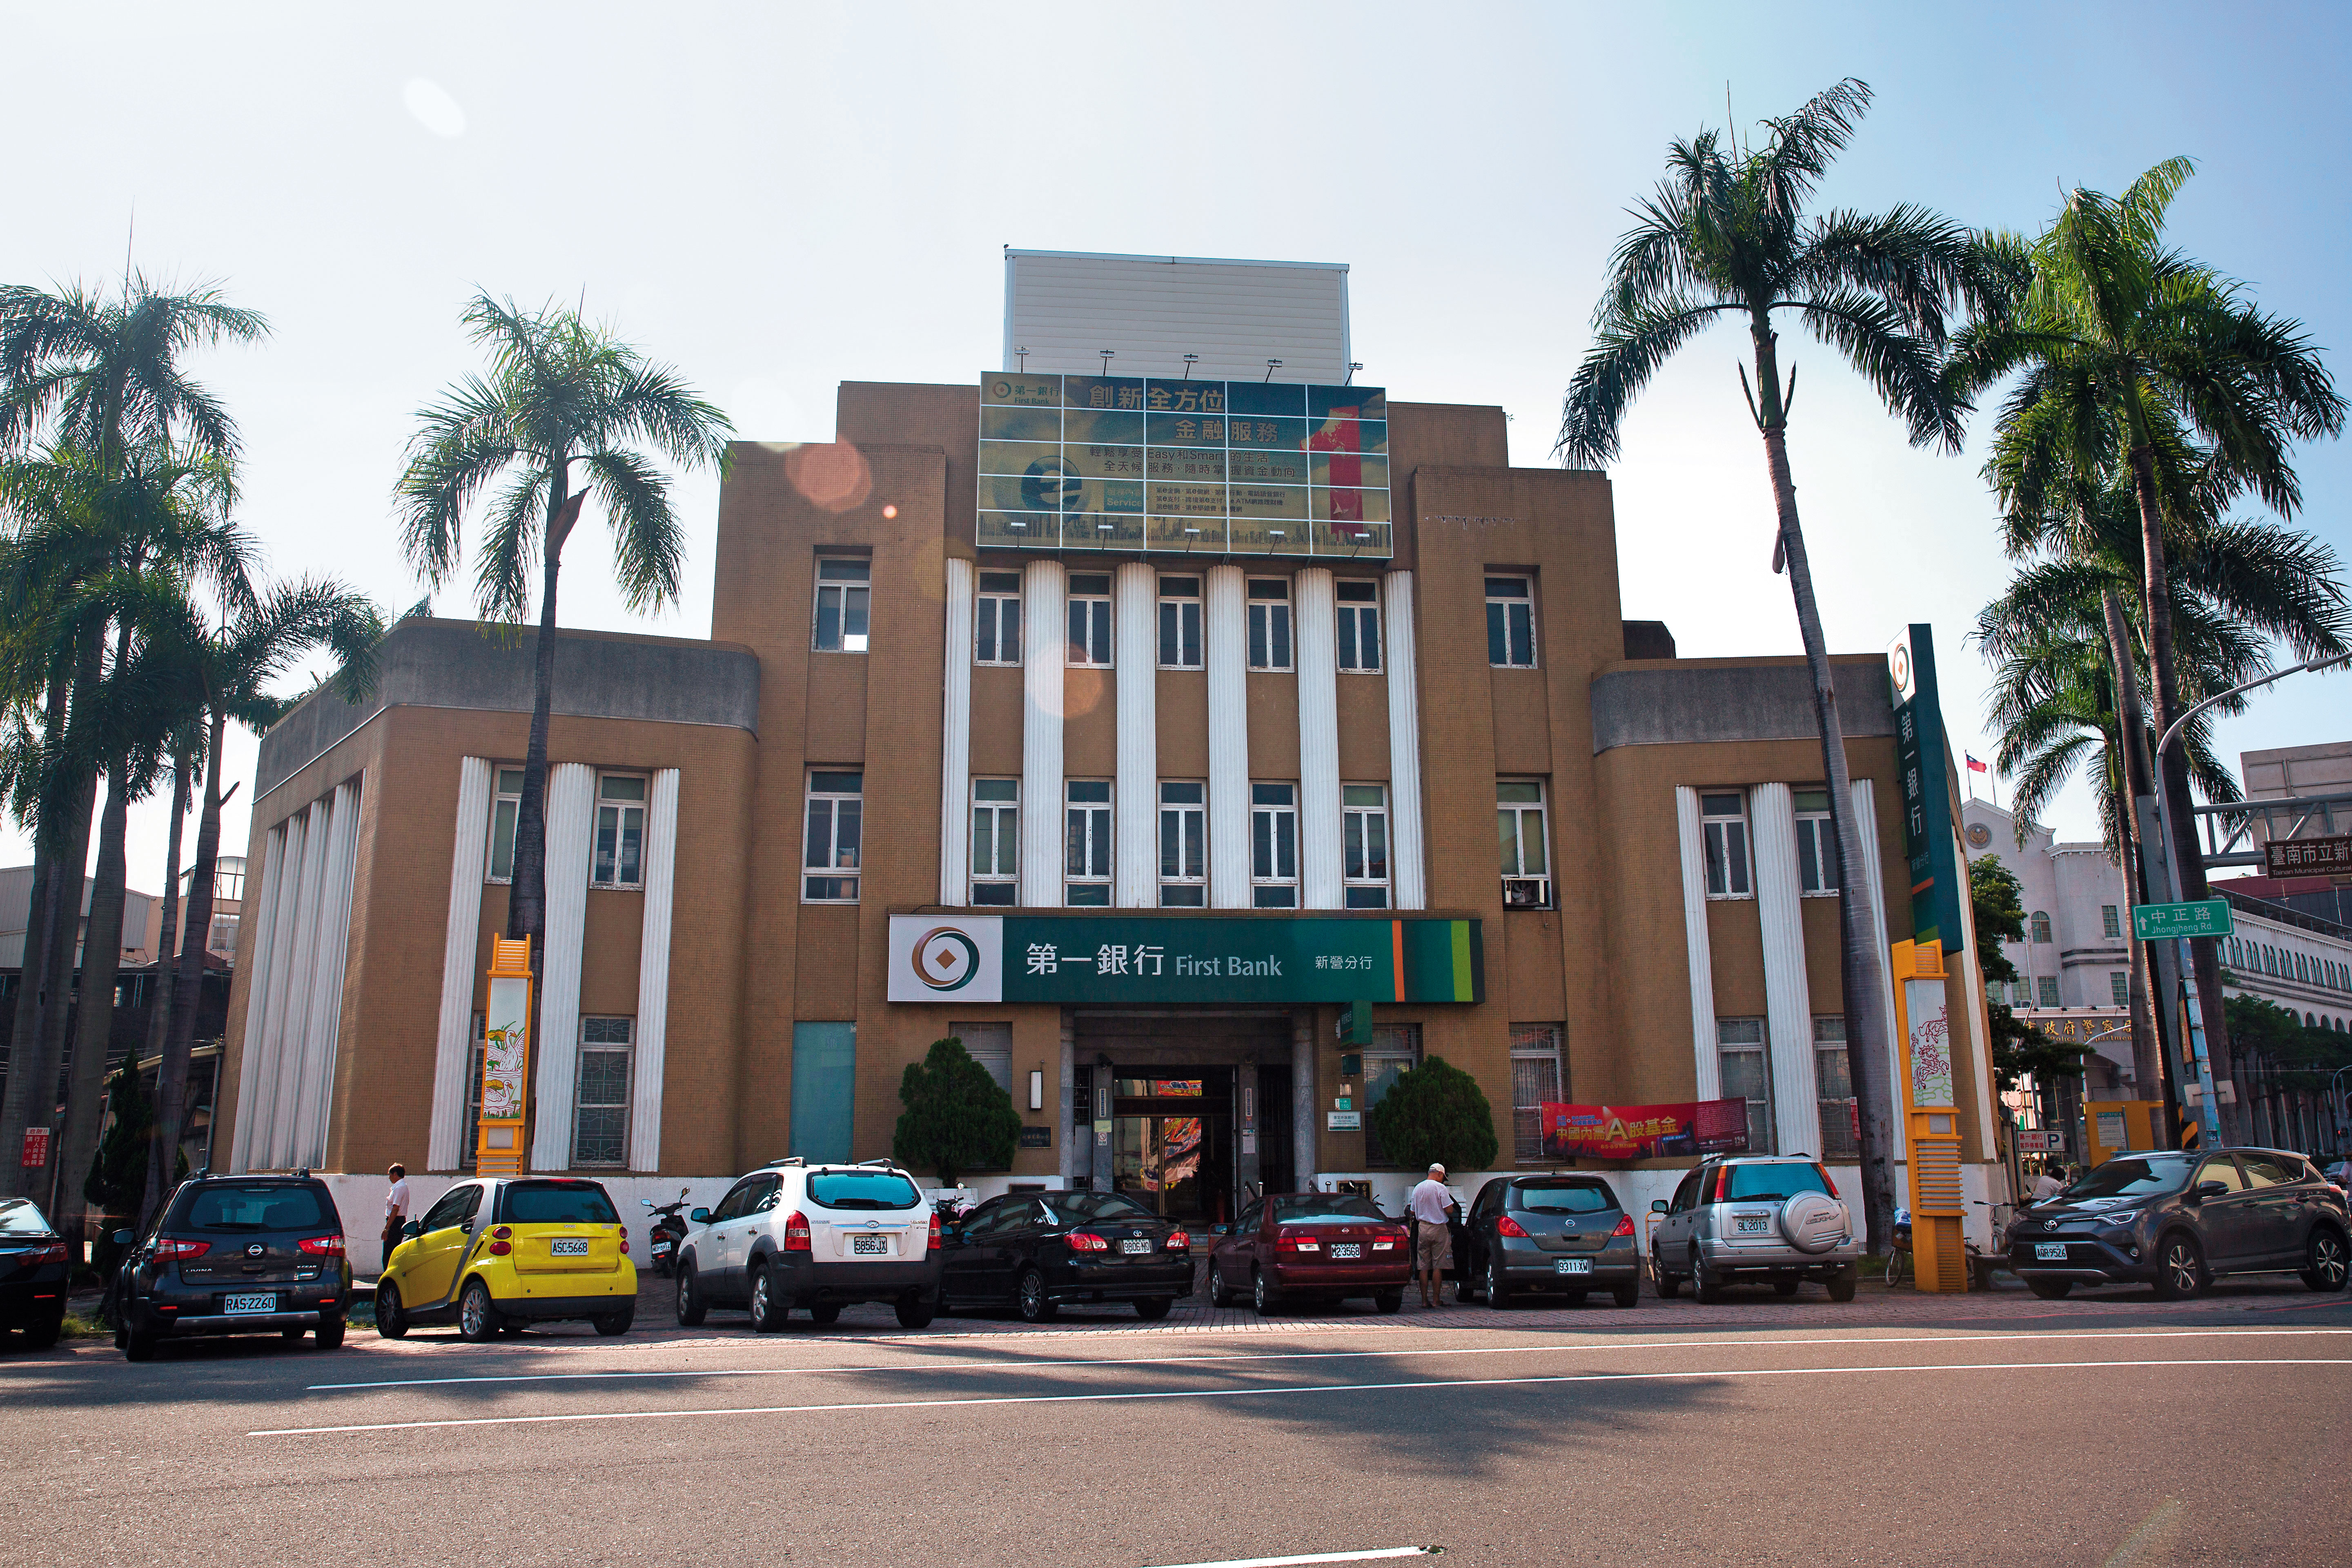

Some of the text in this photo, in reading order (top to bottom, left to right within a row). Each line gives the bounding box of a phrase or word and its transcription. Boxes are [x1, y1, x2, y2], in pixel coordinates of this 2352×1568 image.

[1015, 385, 1059, 397] 第一銀行
[1089, 385, 1224, 412] 創新全方位
[1175, 419, 1278, 443] 金融服務
[1107, 498, 1142, 507] Service
[1901, 711, 1922, 836] 第一銀行
[2270, 841, 2352, 865] 臺南市立新
[2151, 906, 2211, 923] 中正路
[2152, 922, 2214, 934] Jhongjheng Rd.
[1027, 943, 1165, 976] 第一銀行
[1176, 954, 1282, 976] First Bank
[1315, 955, 1372, 970] 新營分行
[2047, 1134, 2060, 1148] P
